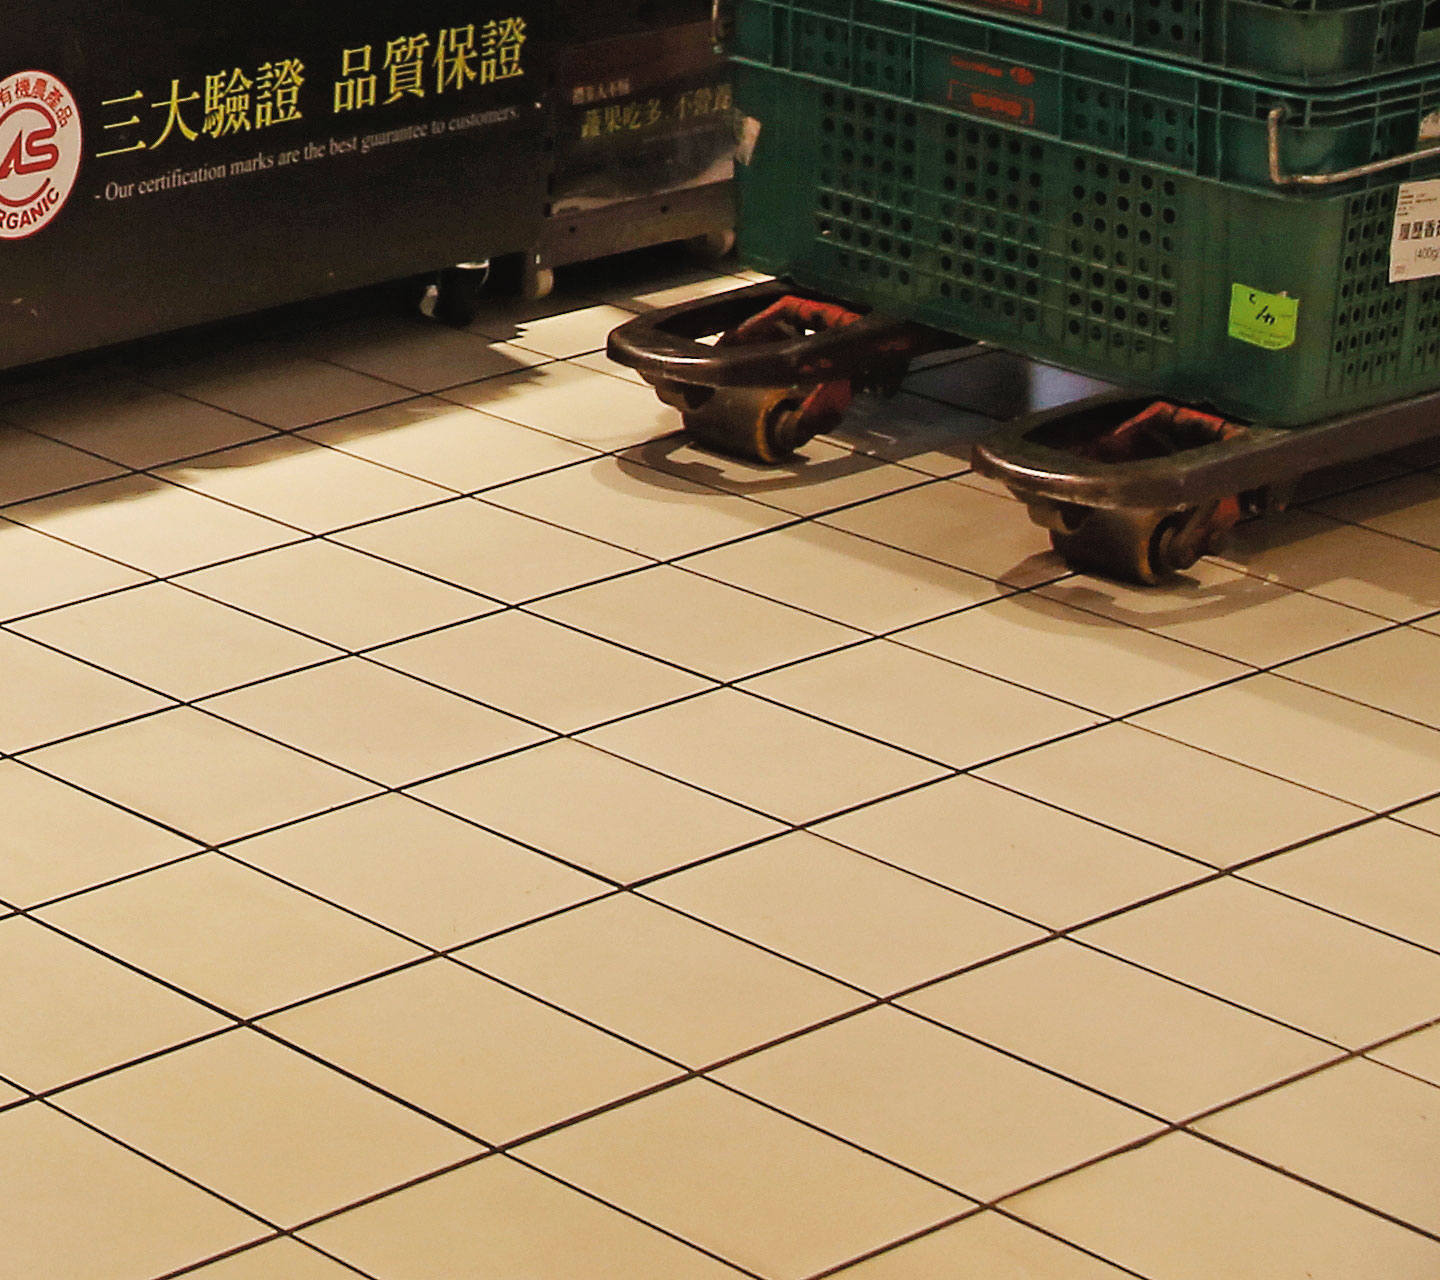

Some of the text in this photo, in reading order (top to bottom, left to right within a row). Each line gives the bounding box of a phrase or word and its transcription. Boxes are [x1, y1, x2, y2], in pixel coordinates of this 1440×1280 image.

[96, 16, 528, 158] 三大驗證 品質保證
[105, 180, 134, 201] Our
[138, 164, 227, 196] certification
[230, 151, 275, 175] marks
[278, 149, 301, 166] are
[304, 143, 326, 161] the
[330, 136, 357, 156] best
[361, 125, 427, 155] guarantee
[431, 121, 446, 138] to
